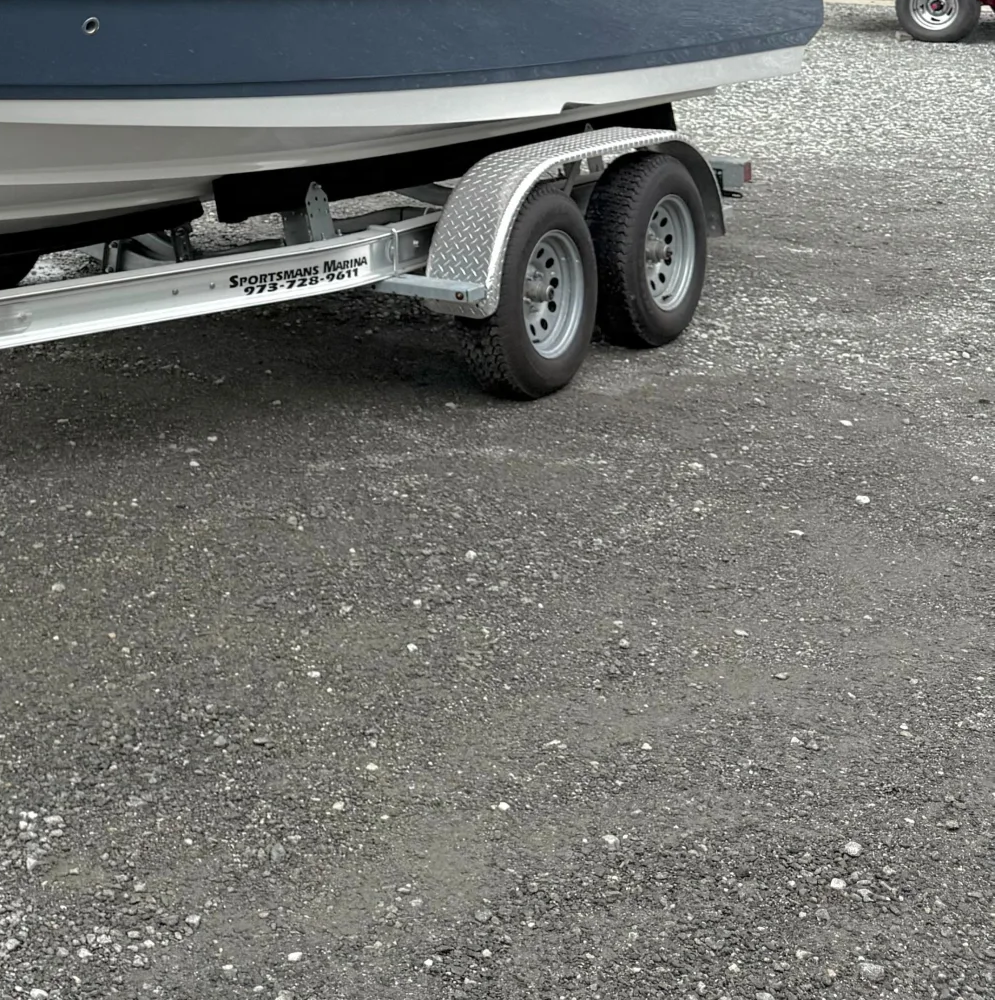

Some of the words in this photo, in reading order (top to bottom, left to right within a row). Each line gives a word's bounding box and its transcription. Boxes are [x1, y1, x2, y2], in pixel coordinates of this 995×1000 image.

[229, 265, 320, 288] SPORTSMANS
[323, 256, 368, 273] MARINA
[244, 268, 359, 296] 973-728-9611
